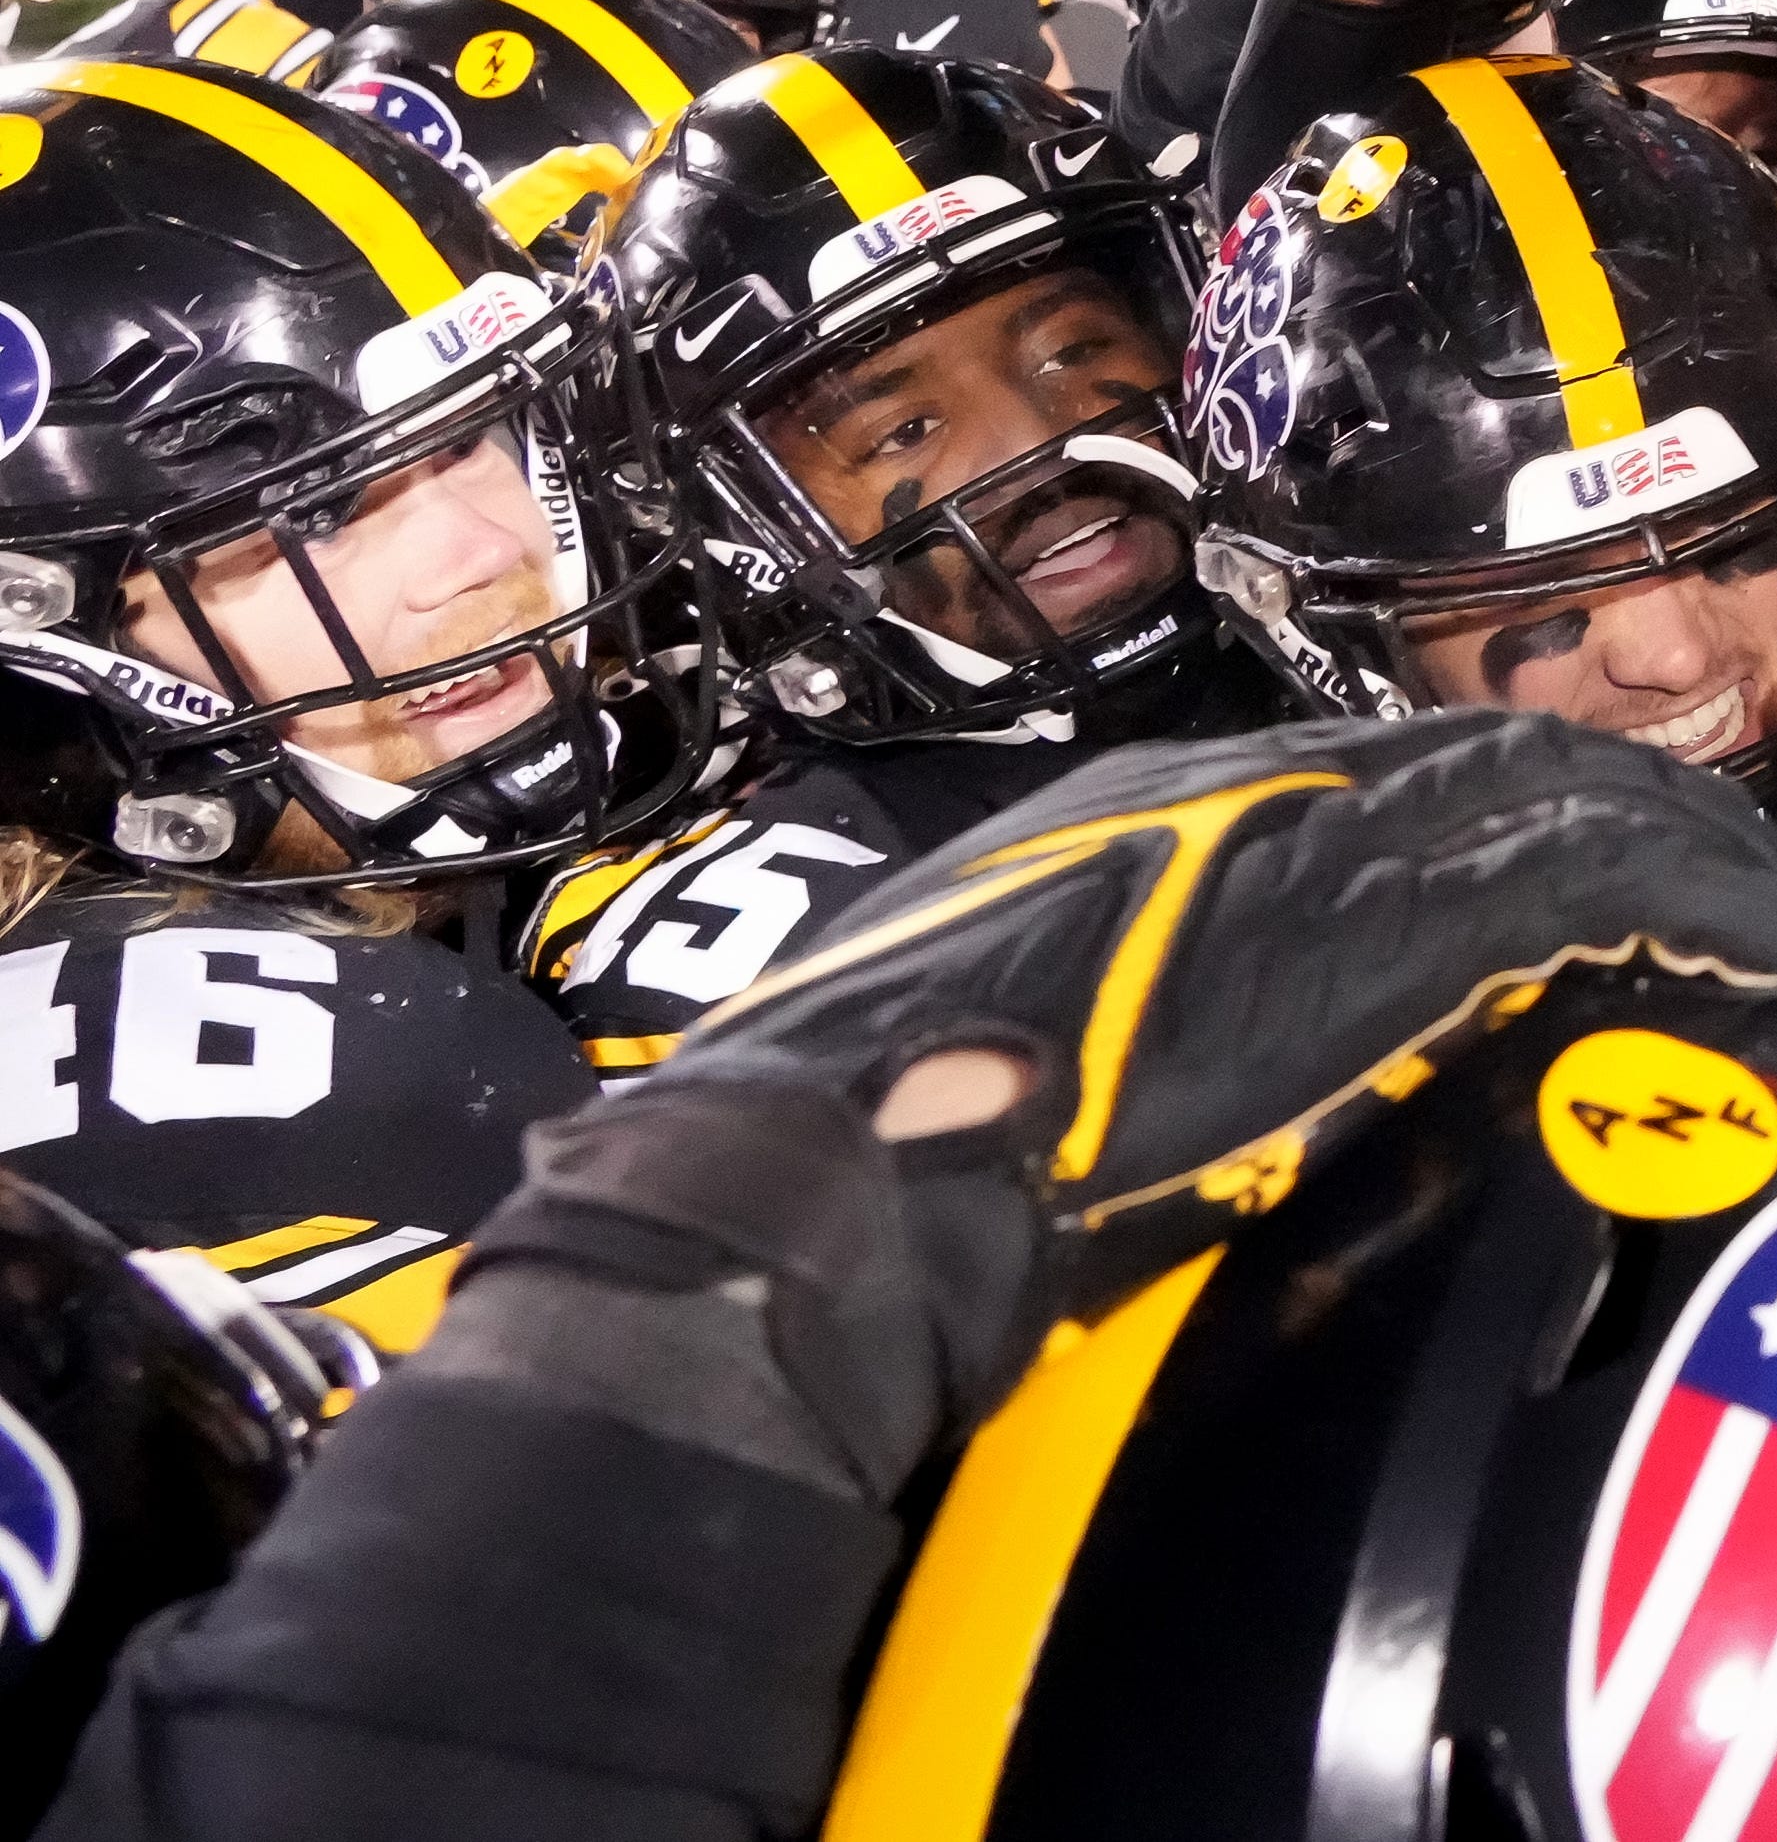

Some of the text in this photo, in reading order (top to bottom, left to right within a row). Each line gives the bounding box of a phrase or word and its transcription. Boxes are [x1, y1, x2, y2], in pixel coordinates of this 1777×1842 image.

[1335, 143, 1385, 218] AF
[420, 289, 528, 366] USA
[1566, 436, 1698, 510] USA
[1568, 1094, 1770, 1149] ANF
